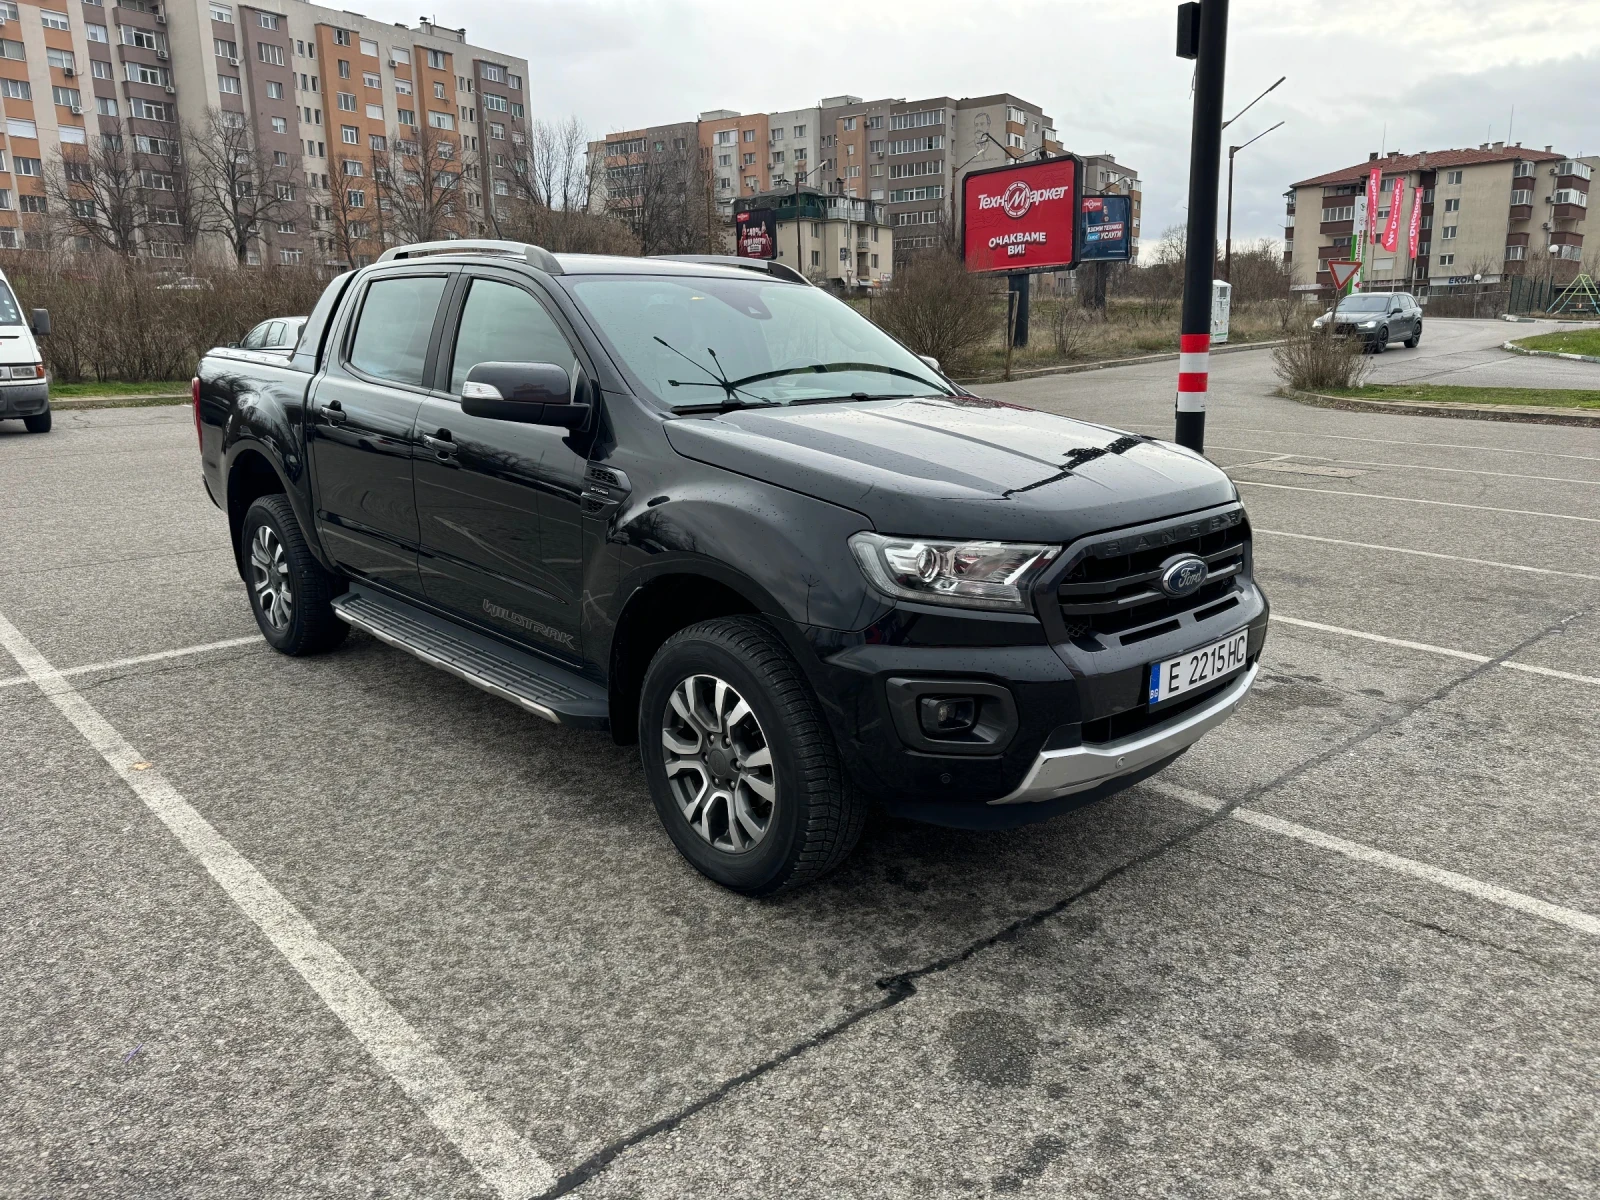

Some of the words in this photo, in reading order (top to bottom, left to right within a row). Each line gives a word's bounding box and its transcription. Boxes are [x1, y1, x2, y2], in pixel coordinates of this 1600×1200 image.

[988, 231, 1047, 249] ОЧАКВАМЕ
[1100, 231, 1122, 239] УСЛУГИ
[1007, 245, 1026, 256] ВИ!
[1448, 276, 1477, 284] ЕКОН
[1107, 513, 1241, 555] RANGER
[1179, 566, 1203, 588] Ford
[482, 598, 576, 651] WILDTRAK
[1168, 661, 1181, 693] E
[1149, 689, 1158, 699] BG
